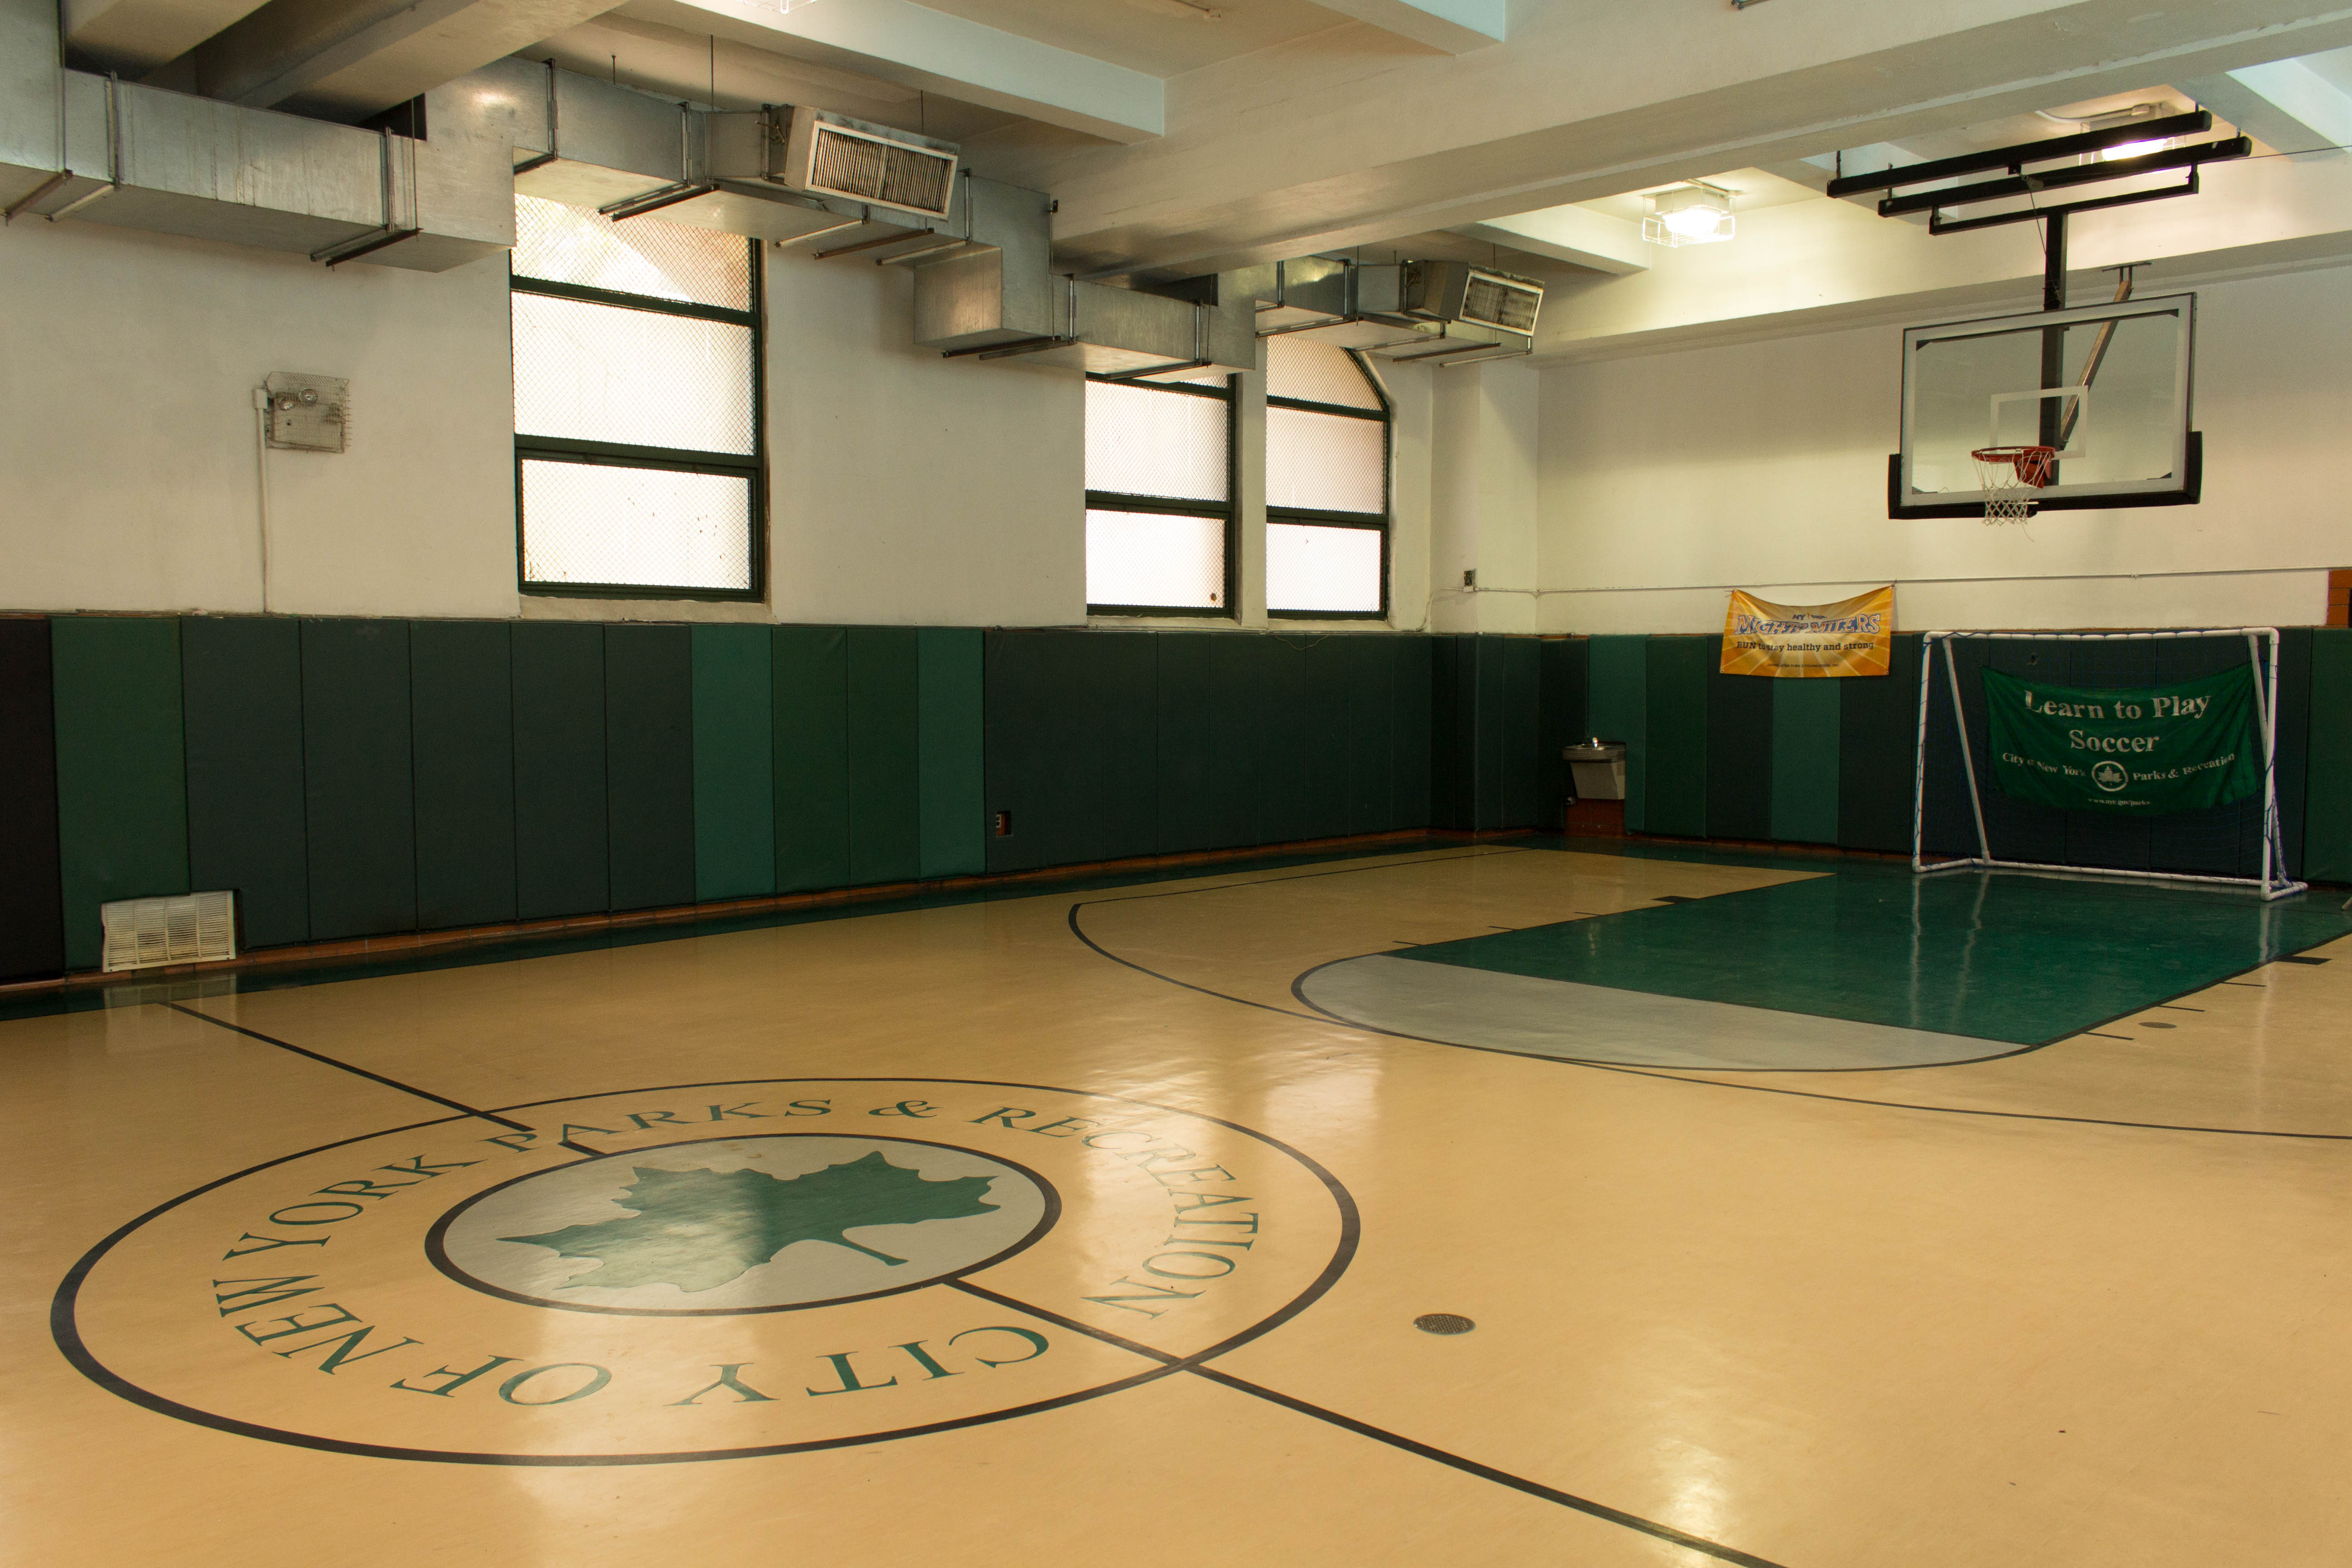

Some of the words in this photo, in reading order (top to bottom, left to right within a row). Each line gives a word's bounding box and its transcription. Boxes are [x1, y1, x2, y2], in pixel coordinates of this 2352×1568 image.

[1734, 615, 1808, 635] MIGHTY
[1805, 613, 1881, 634] MILERS
[1766, 644, 1785, 652] stay
[1786, 643, 1821, 652] healthy
[2024, 690, 2105, 719] Learn
[2113, 700, 2141, 719] to
[2150, 695, 2211, 719] Play
[2069, 729, 2160, 753] Soccer
[2003, 752, 2024, 766] City
[2037, 760, 2058, 774] New
[2062, 764, 2087, 777] York
[2133, 770, 2166, 781] Parks
[2168, 769, 2180, 779] &
[2183, 753, 2236, 775] Rereation
[476, 1099, 832, 1153] PARKS
[867, 1100, 943, 1118] &
[222, 1153, 488, 1261] YORK
[963, 1106, 1259, 1320] RECREATION
[212, 1274, 425, 1375] NEW
[389, 1354, 612, 1406] OF
[662, 1325, 1049, 1406] CITY
